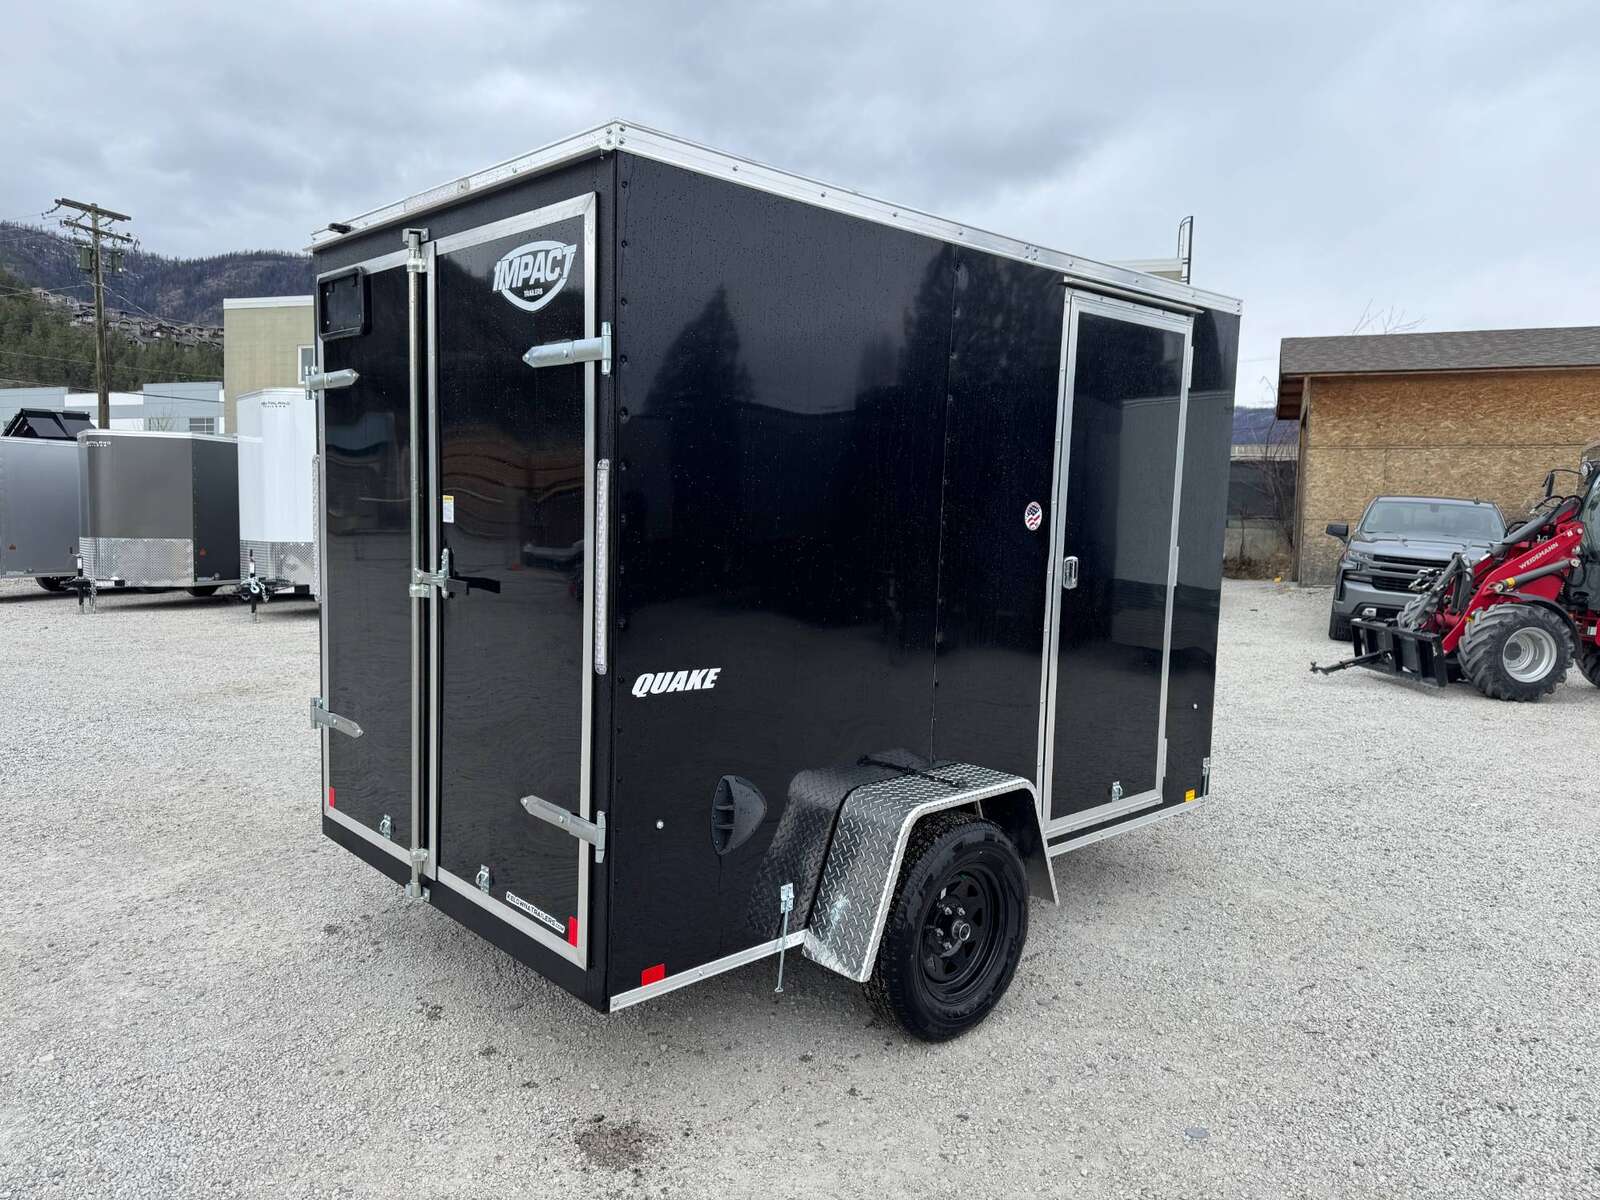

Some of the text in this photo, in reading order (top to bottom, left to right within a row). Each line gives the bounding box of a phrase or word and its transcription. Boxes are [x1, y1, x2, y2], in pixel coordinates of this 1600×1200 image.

[492, 244, 577, 291] IMPACT
[1518, 542, 1559, 570] WEIDEMANN
[631, 667, 722, 698] QUAKE
